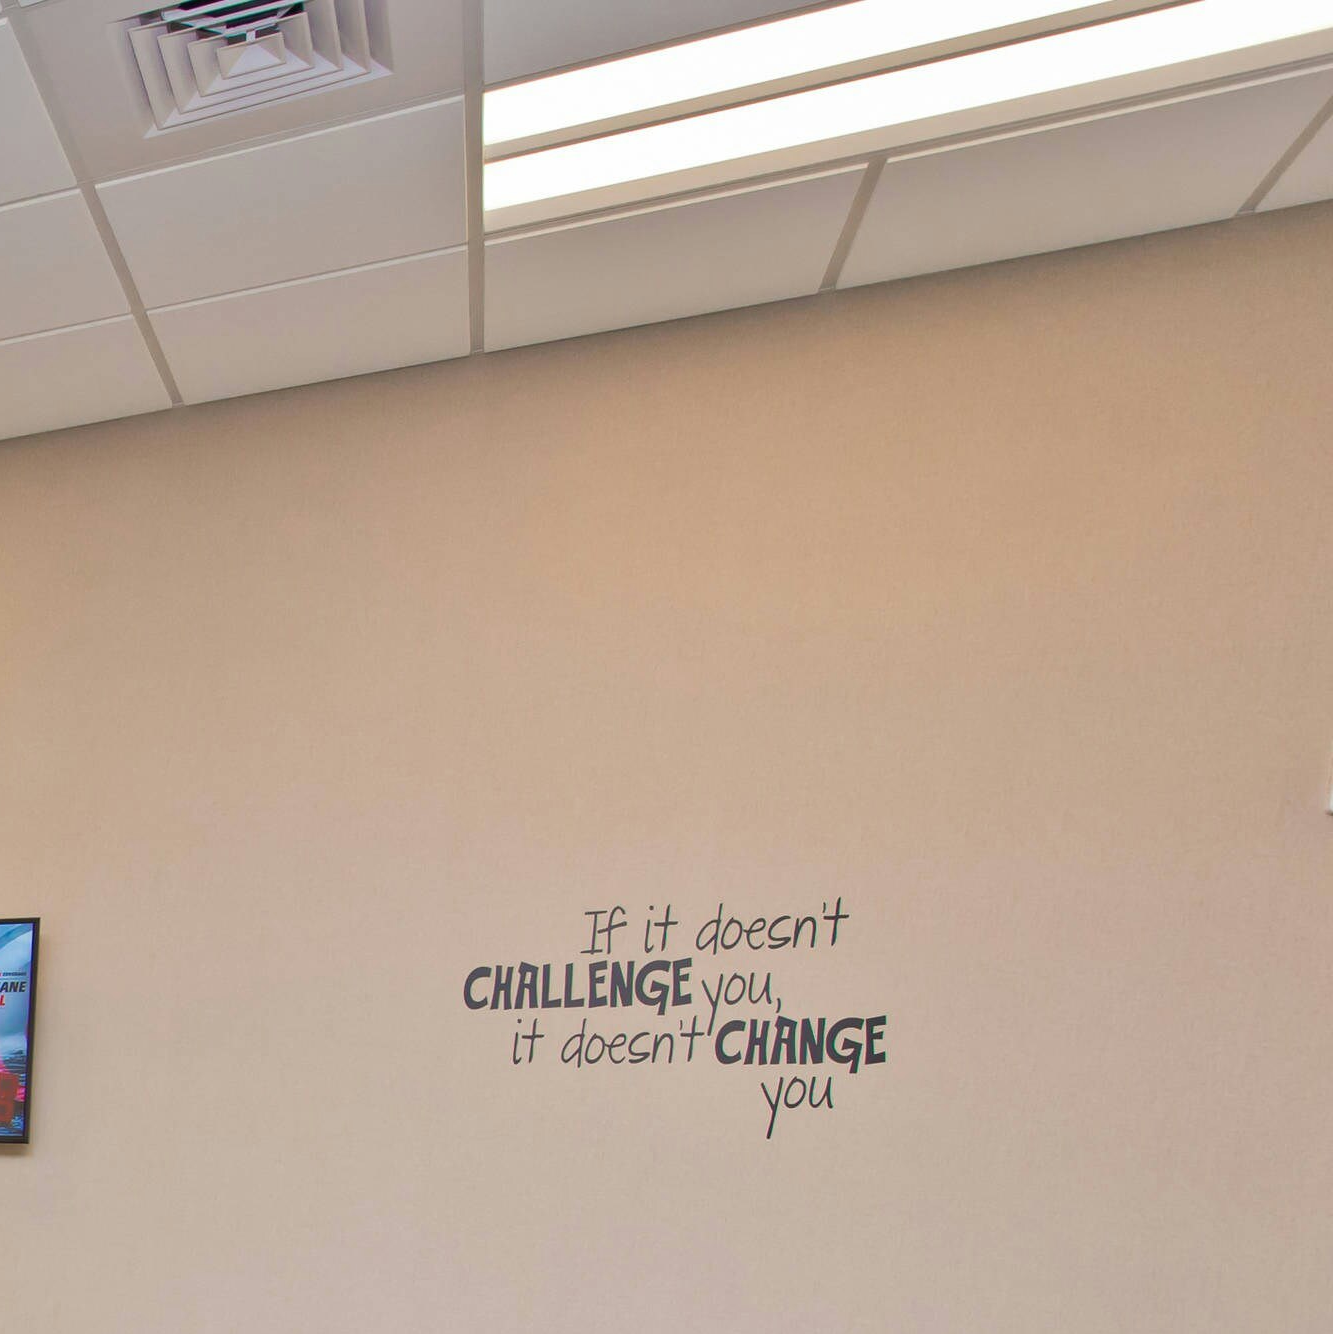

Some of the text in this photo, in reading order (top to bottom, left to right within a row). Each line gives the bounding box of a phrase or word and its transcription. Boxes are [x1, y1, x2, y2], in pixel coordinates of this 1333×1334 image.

[580, 897, 849, 955] If it doesn't
[463, 957, 693, 1016] CHALLENGE
[512, 1014, 887, 1074] it doesn't CHANGE
[760, 1076, 834, 1140] you
